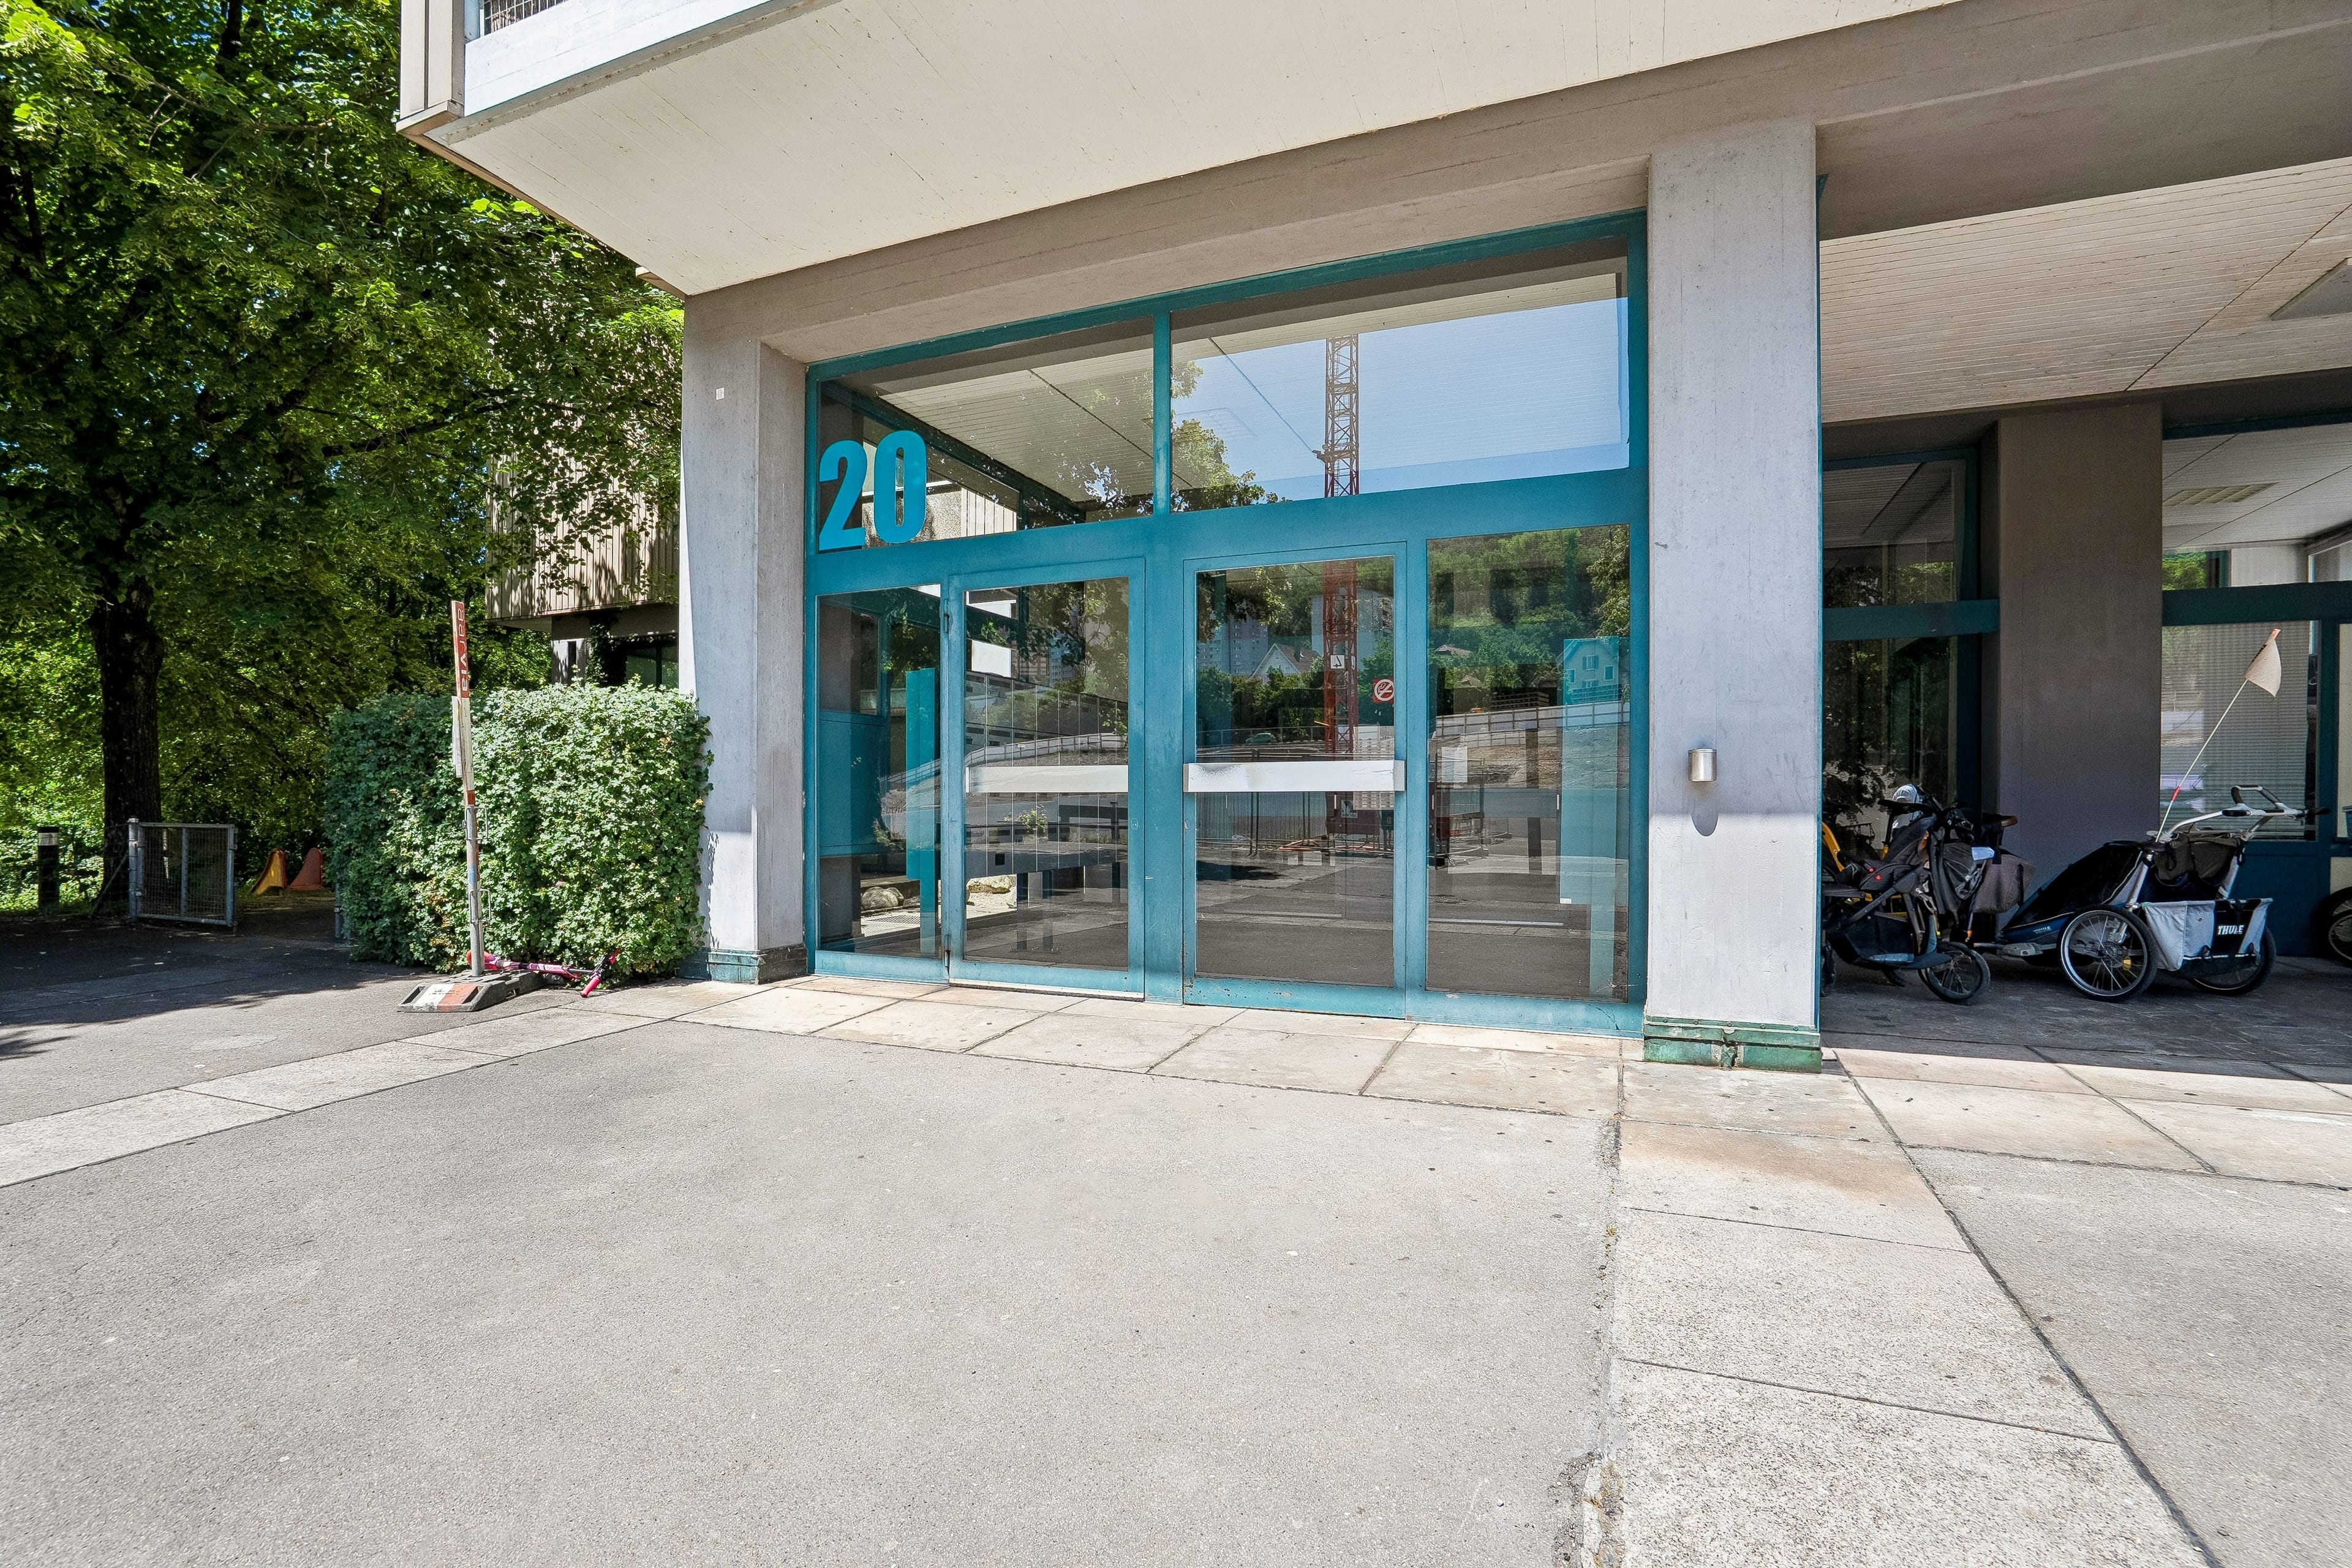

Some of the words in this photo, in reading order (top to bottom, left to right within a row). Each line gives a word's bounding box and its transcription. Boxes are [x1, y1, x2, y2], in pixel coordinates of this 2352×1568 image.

[819, 430, 927, 551] 20
[458, 608, 469, 692] aarvia
[2218, 925, 2244, 935] THULE
